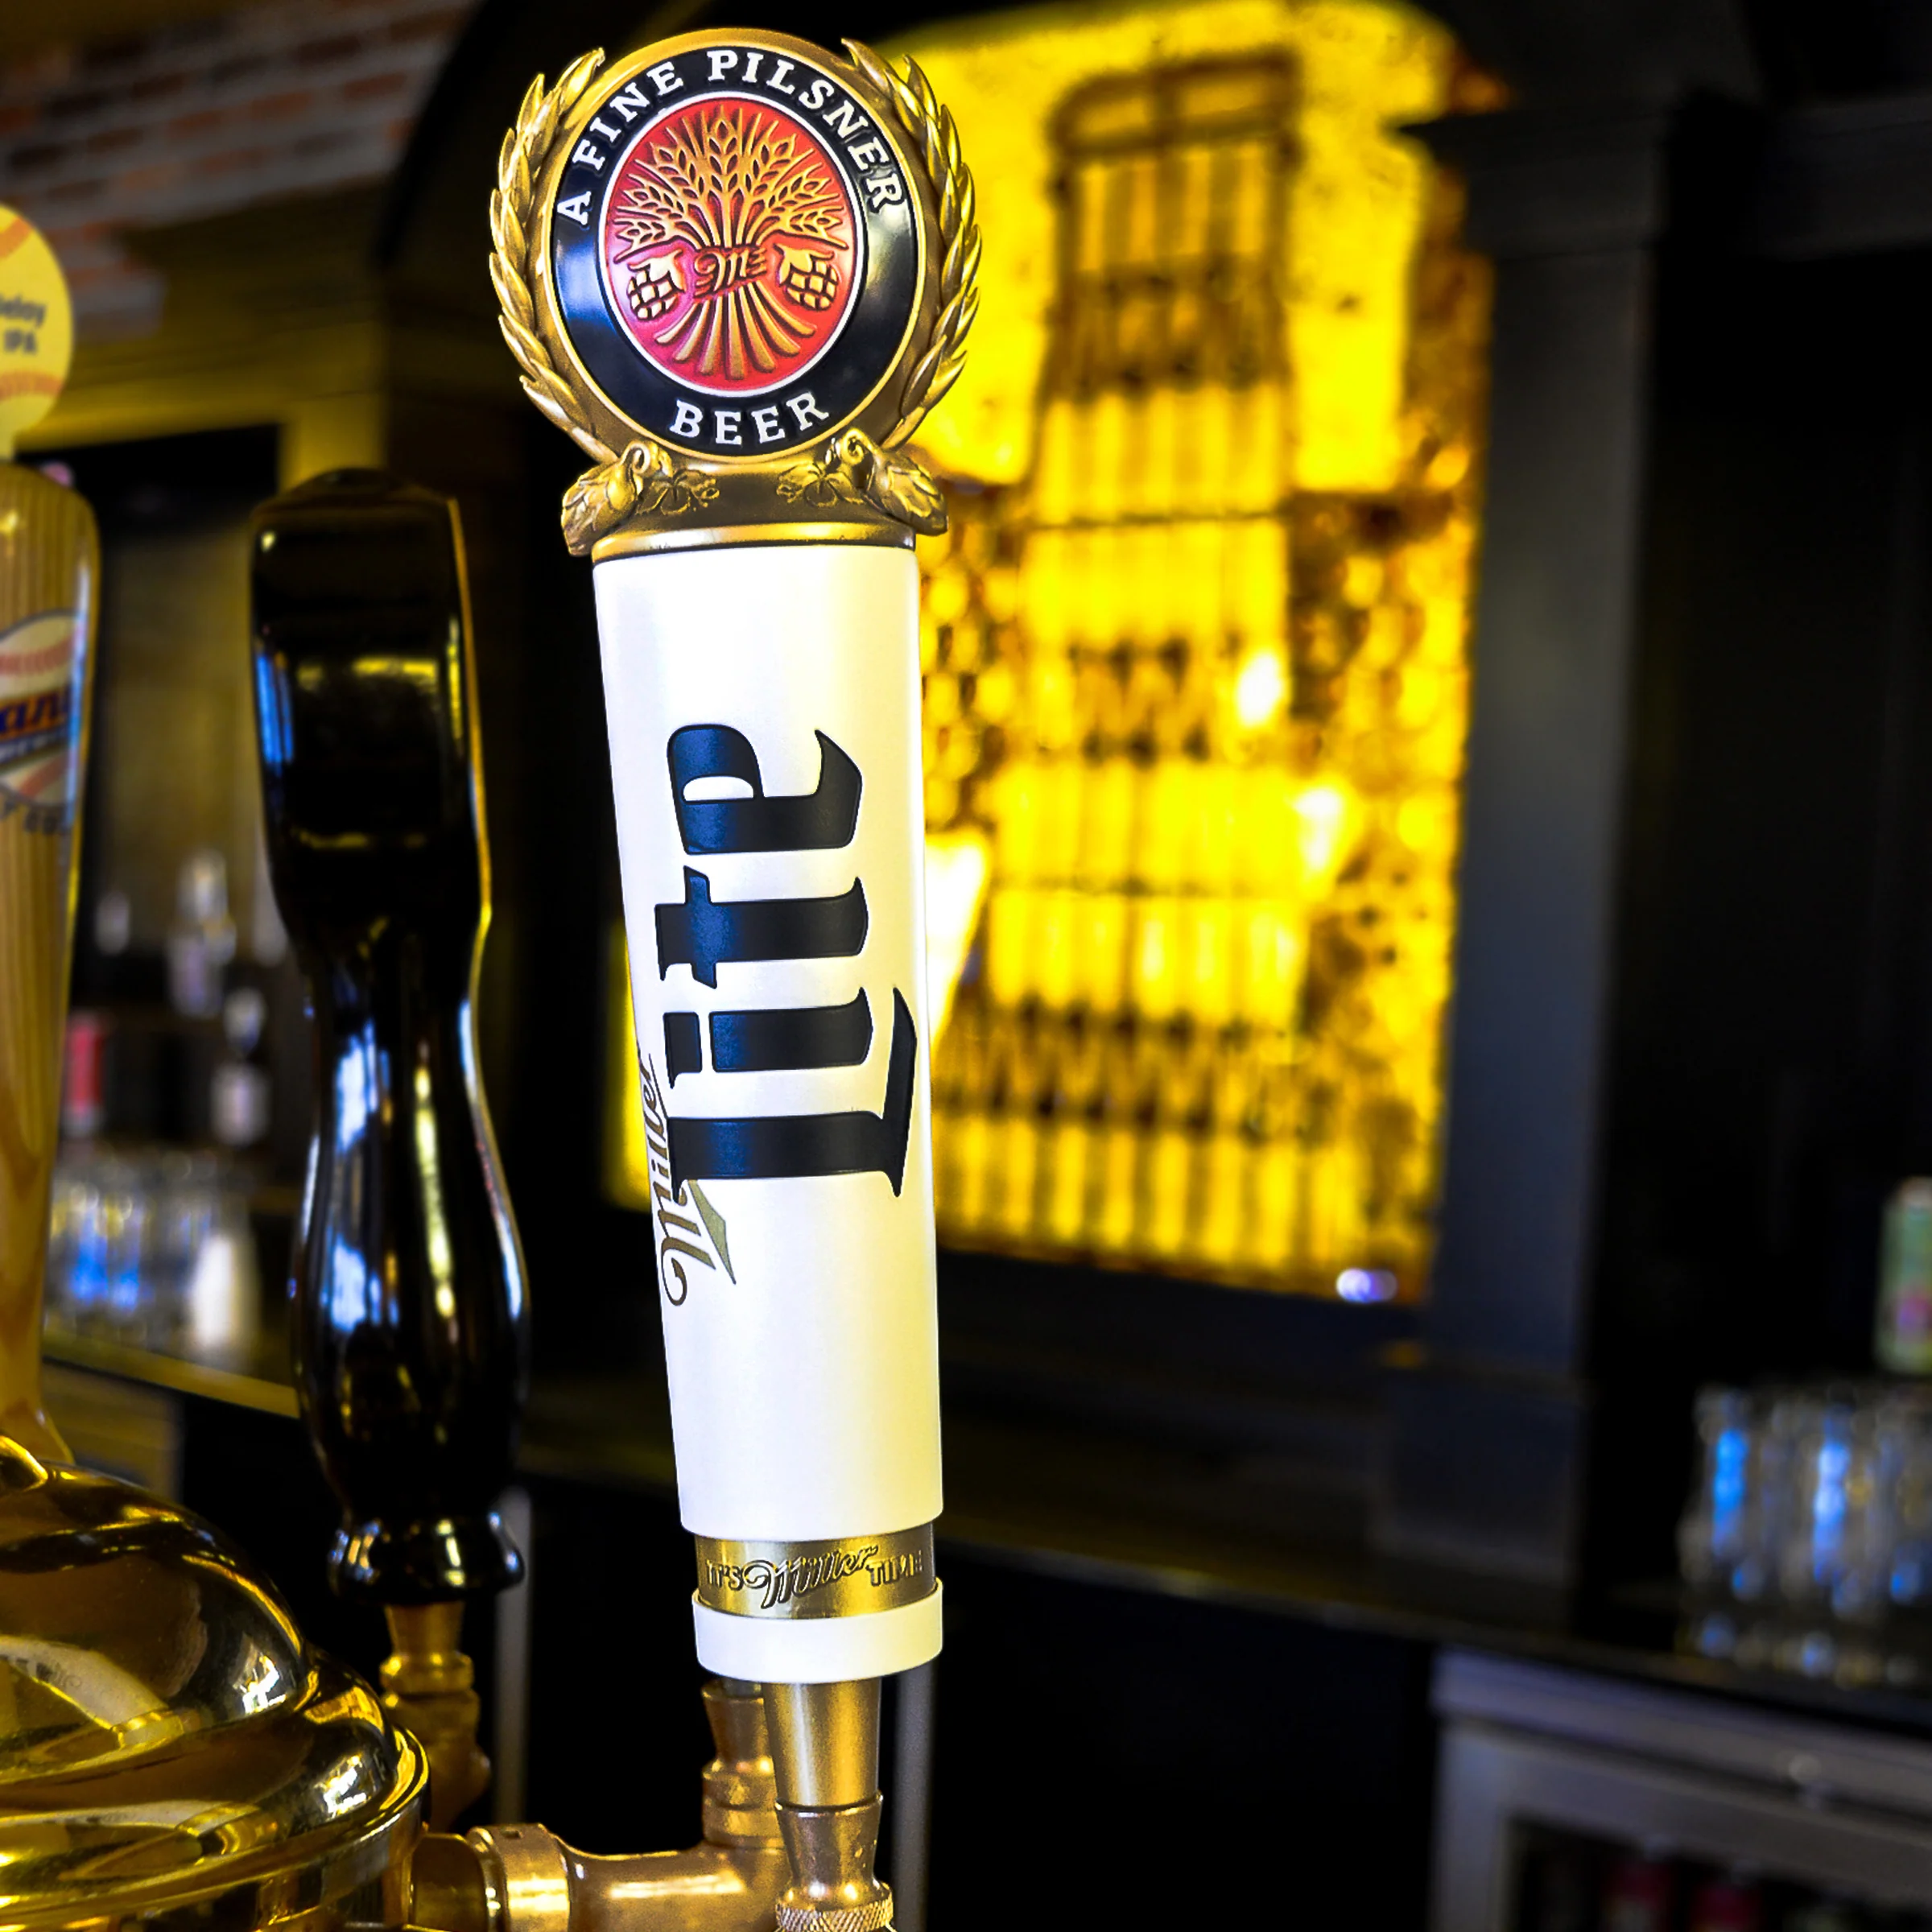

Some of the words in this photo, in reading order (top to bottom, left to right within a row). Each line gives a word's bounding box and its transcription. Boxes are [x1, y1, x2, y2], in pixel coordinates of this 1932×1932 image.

[572, 60, 685, 170] FINE
[706, 48, 906, 216] PILSNER
[556, 190, 592, 225] A
[669, 391, 830, 447] BEER
[654, 723, 917, 1198] Lite
[637, 1040, 718, 1307] Miller
[706, 1559, 743, 1591] IT'S
[742, 1544, 879, 1609] Miller
